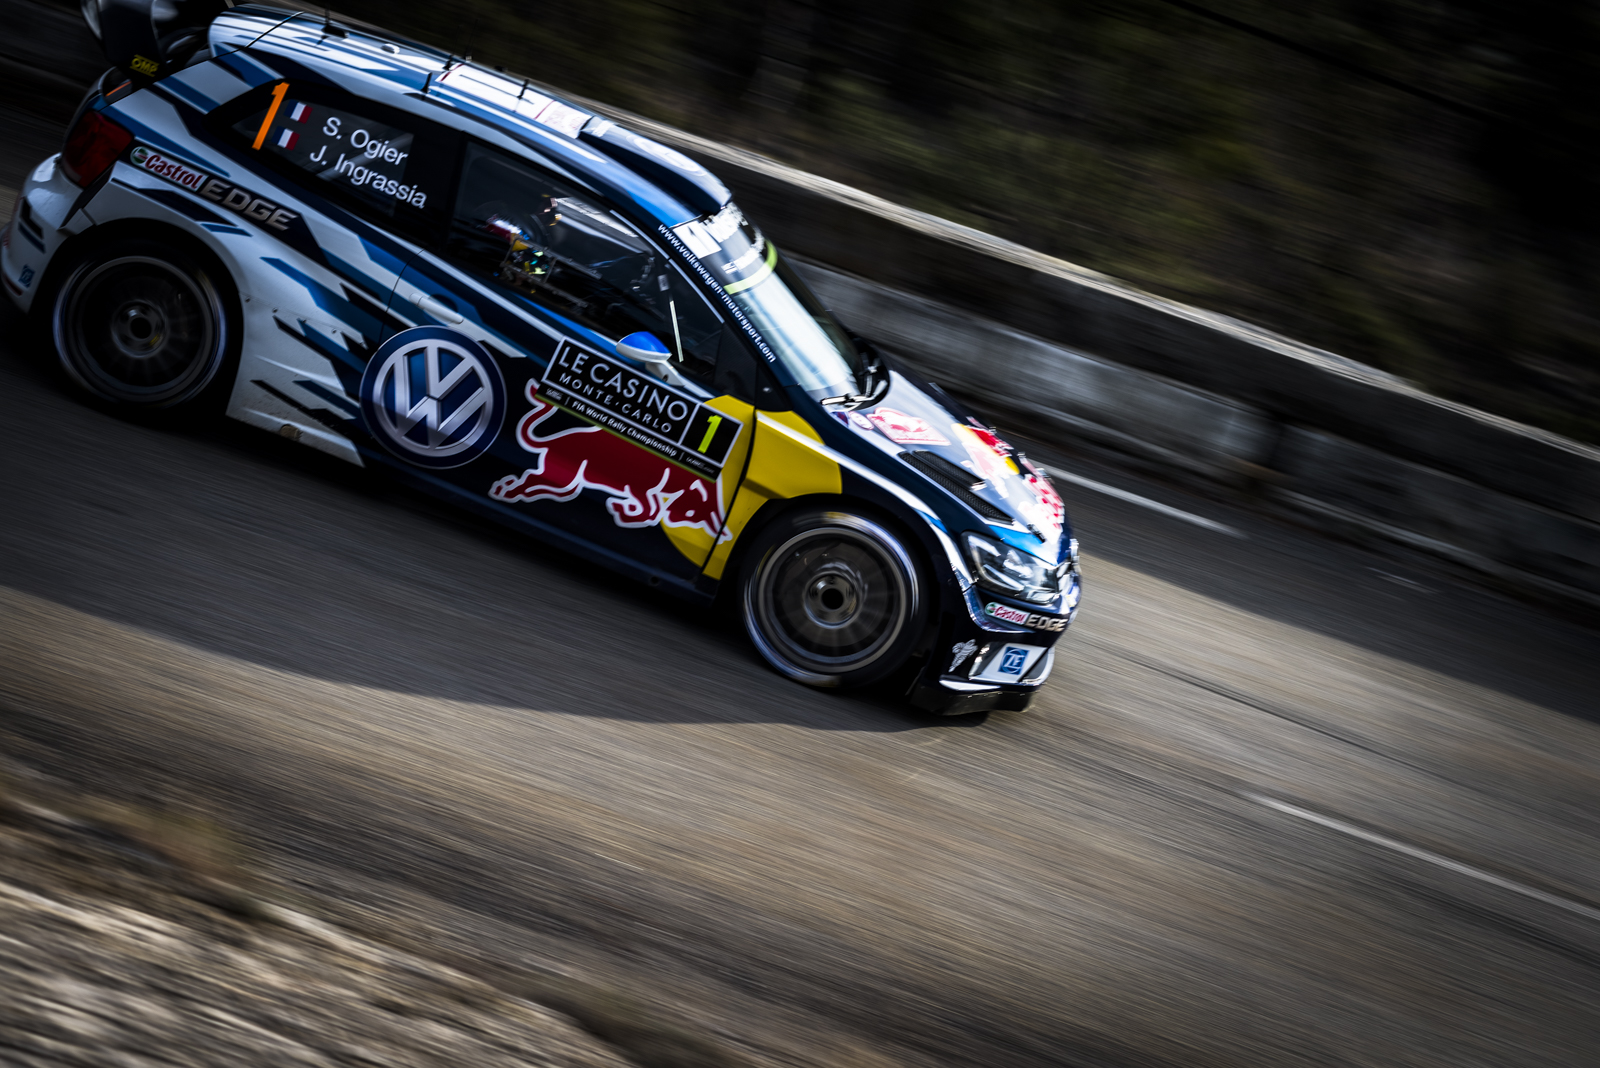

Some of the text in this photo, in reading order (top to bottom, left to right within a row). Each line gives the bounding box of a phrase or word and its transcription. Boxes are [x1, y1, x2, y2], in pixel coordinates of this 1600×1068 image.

[252, 82, 290, 150] 1
[322, 117, 408, 165] S. Ogier
[144, 154, 298, 231] Castrol EDGE
[309, 145, 427, 209] J. Ingrassia
[658, 224, 777, 363] www.volkswagen-motorsport.com
[558, 346, 688, 421] LE CASINO
[572, 400, 678, 457] FIA World Rally Championship
[697, 415, 723, 454] 1
[994, 606, 1069, 632] Castrol EDGE
